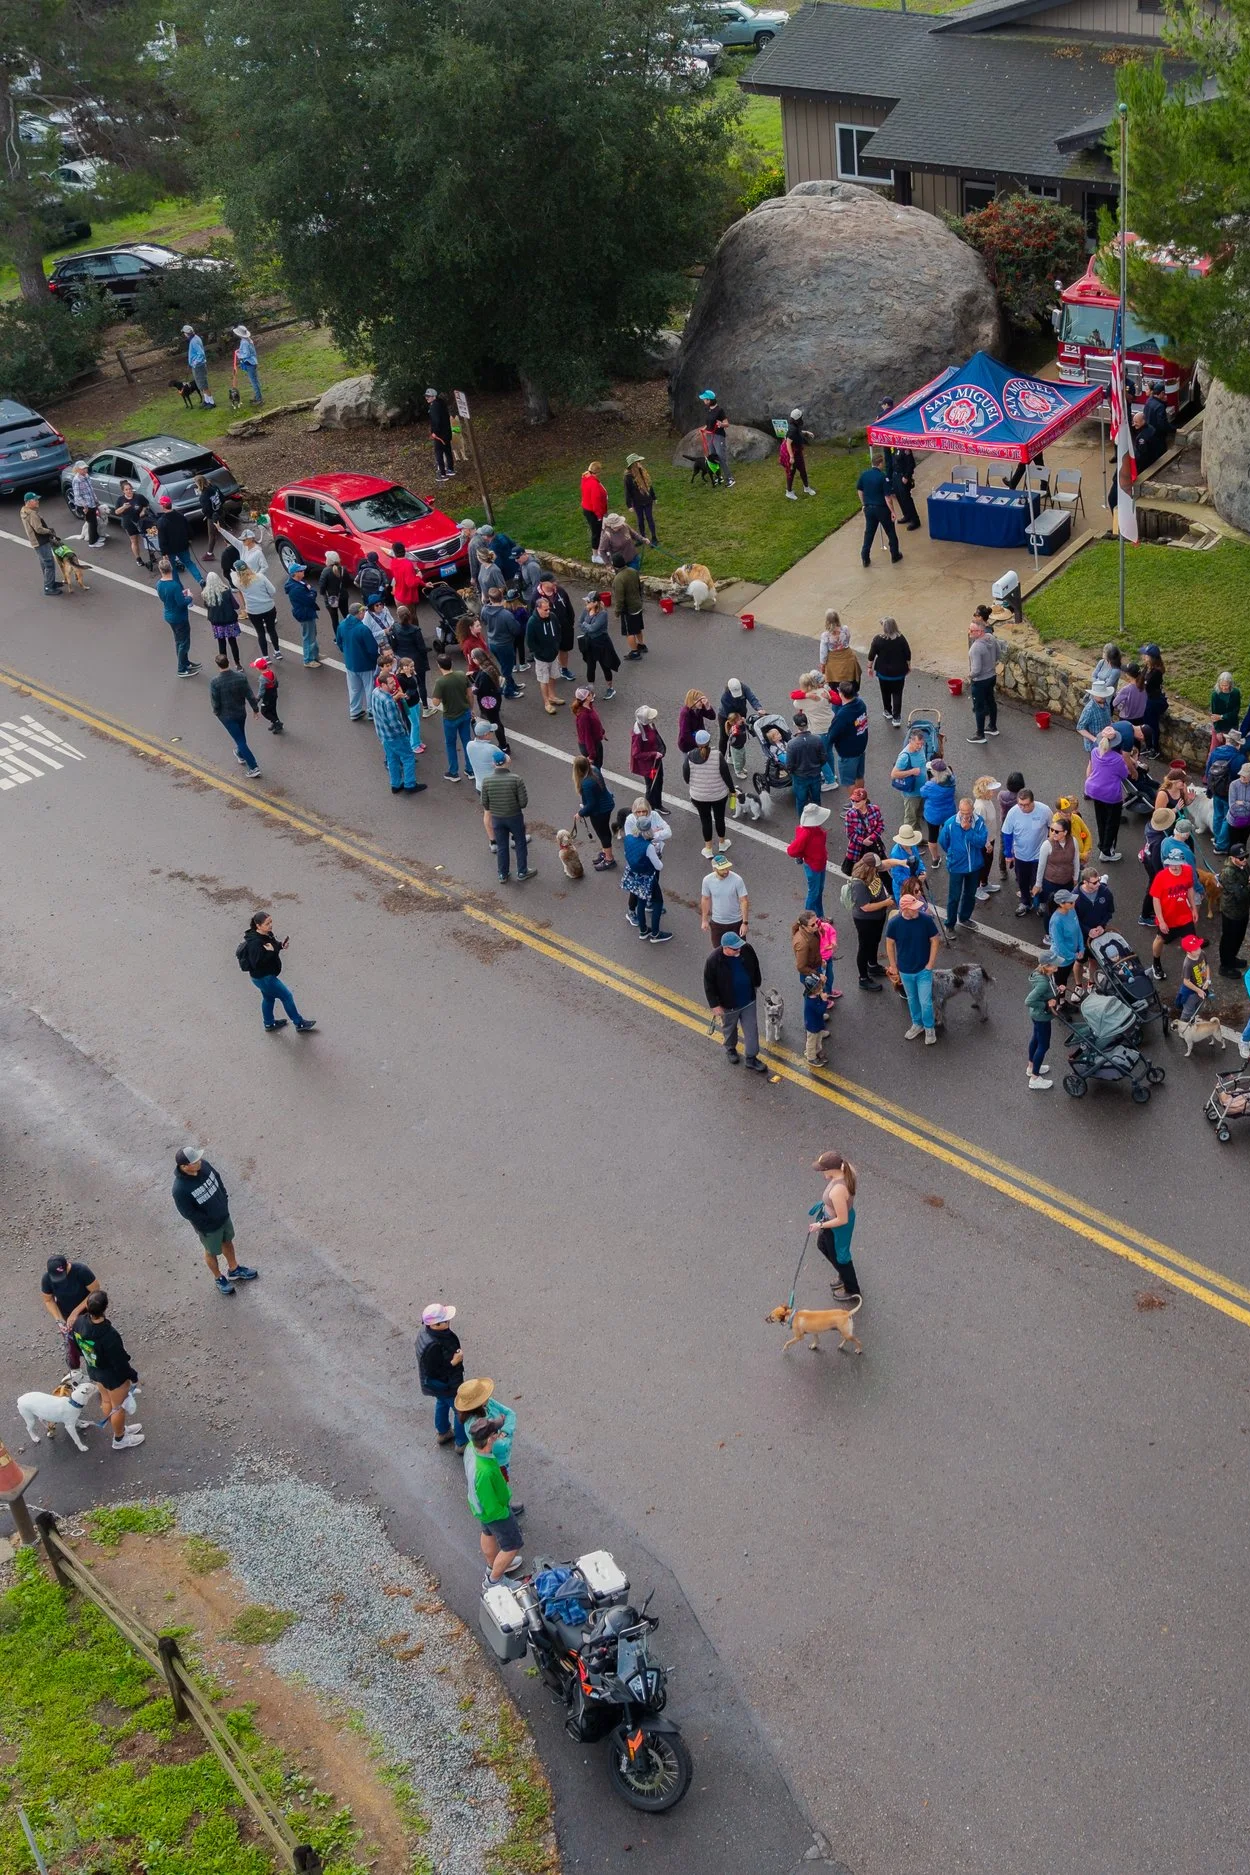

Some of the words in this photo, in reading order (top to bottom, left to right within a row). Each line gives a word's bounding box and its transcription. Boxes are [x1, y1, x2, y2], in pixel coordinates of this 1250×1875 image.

[1064, 344, 1080, 354] E21
[1008, 381, 1052, 395] MIGUEL
[925, 391, 953, 413] SAN
[955, 387, 999, 421] MIGUEL
[1006, 394, 1020, 416] SAN
[870, 432, 892, 445] SAN
